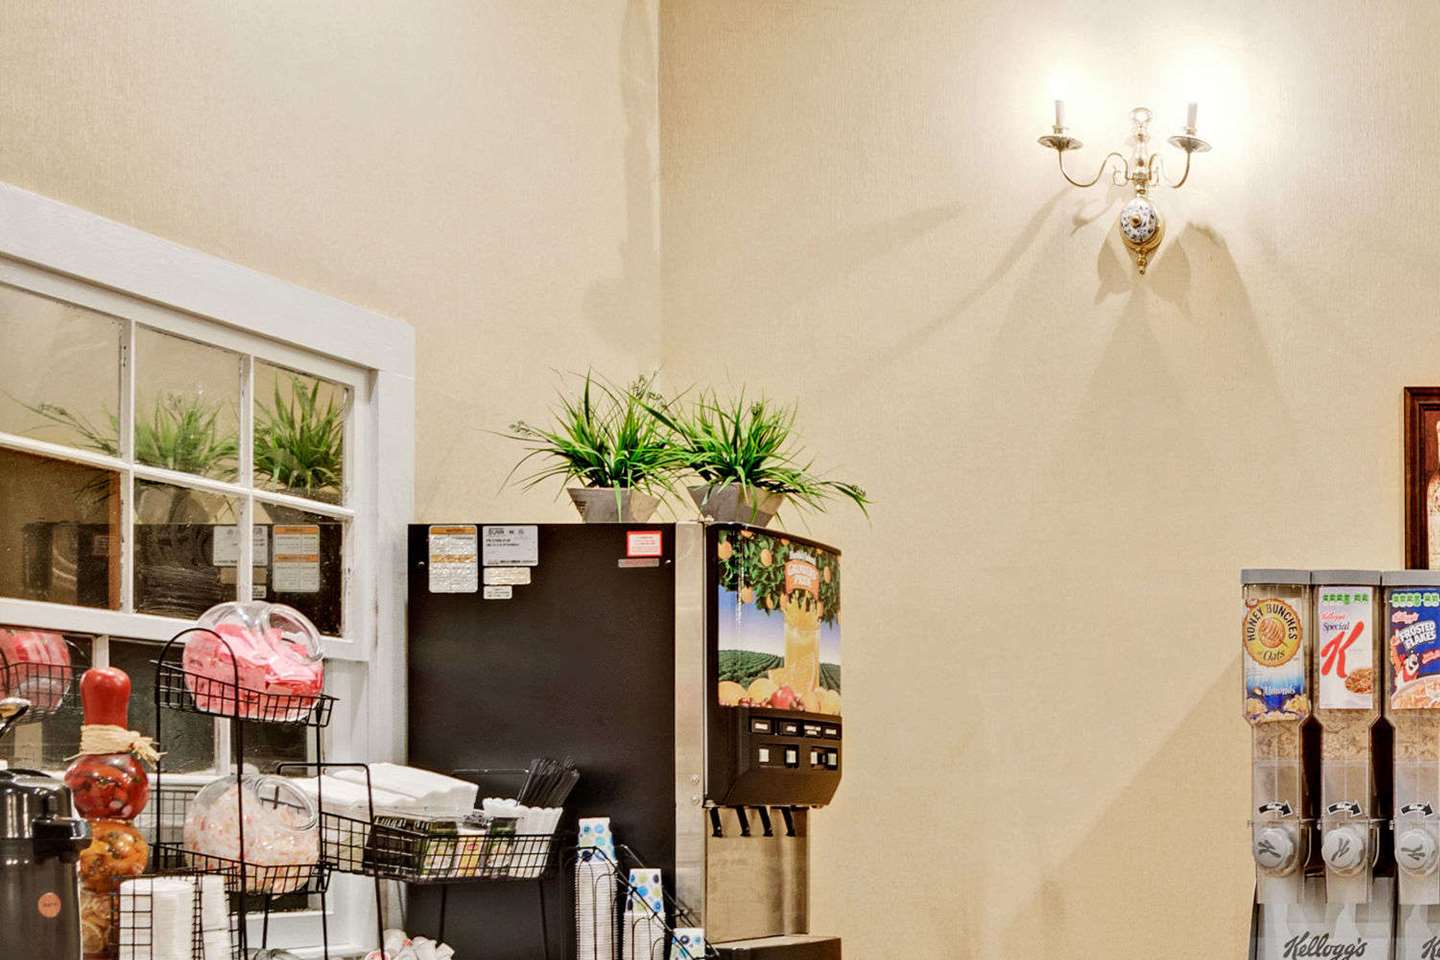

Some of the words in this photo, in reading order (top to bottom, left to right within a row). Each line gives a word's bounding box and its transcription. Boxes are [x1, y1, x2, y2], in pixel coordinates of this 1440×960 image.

[1247, 607, 1264, 641] HONEY
[1266, 603, 1298, 640] BUNCHES
[1323, 621, 1350, 633] Special
[1263, 650, 1285, 661] Oats
[1321, 621, 1364, 678] K
